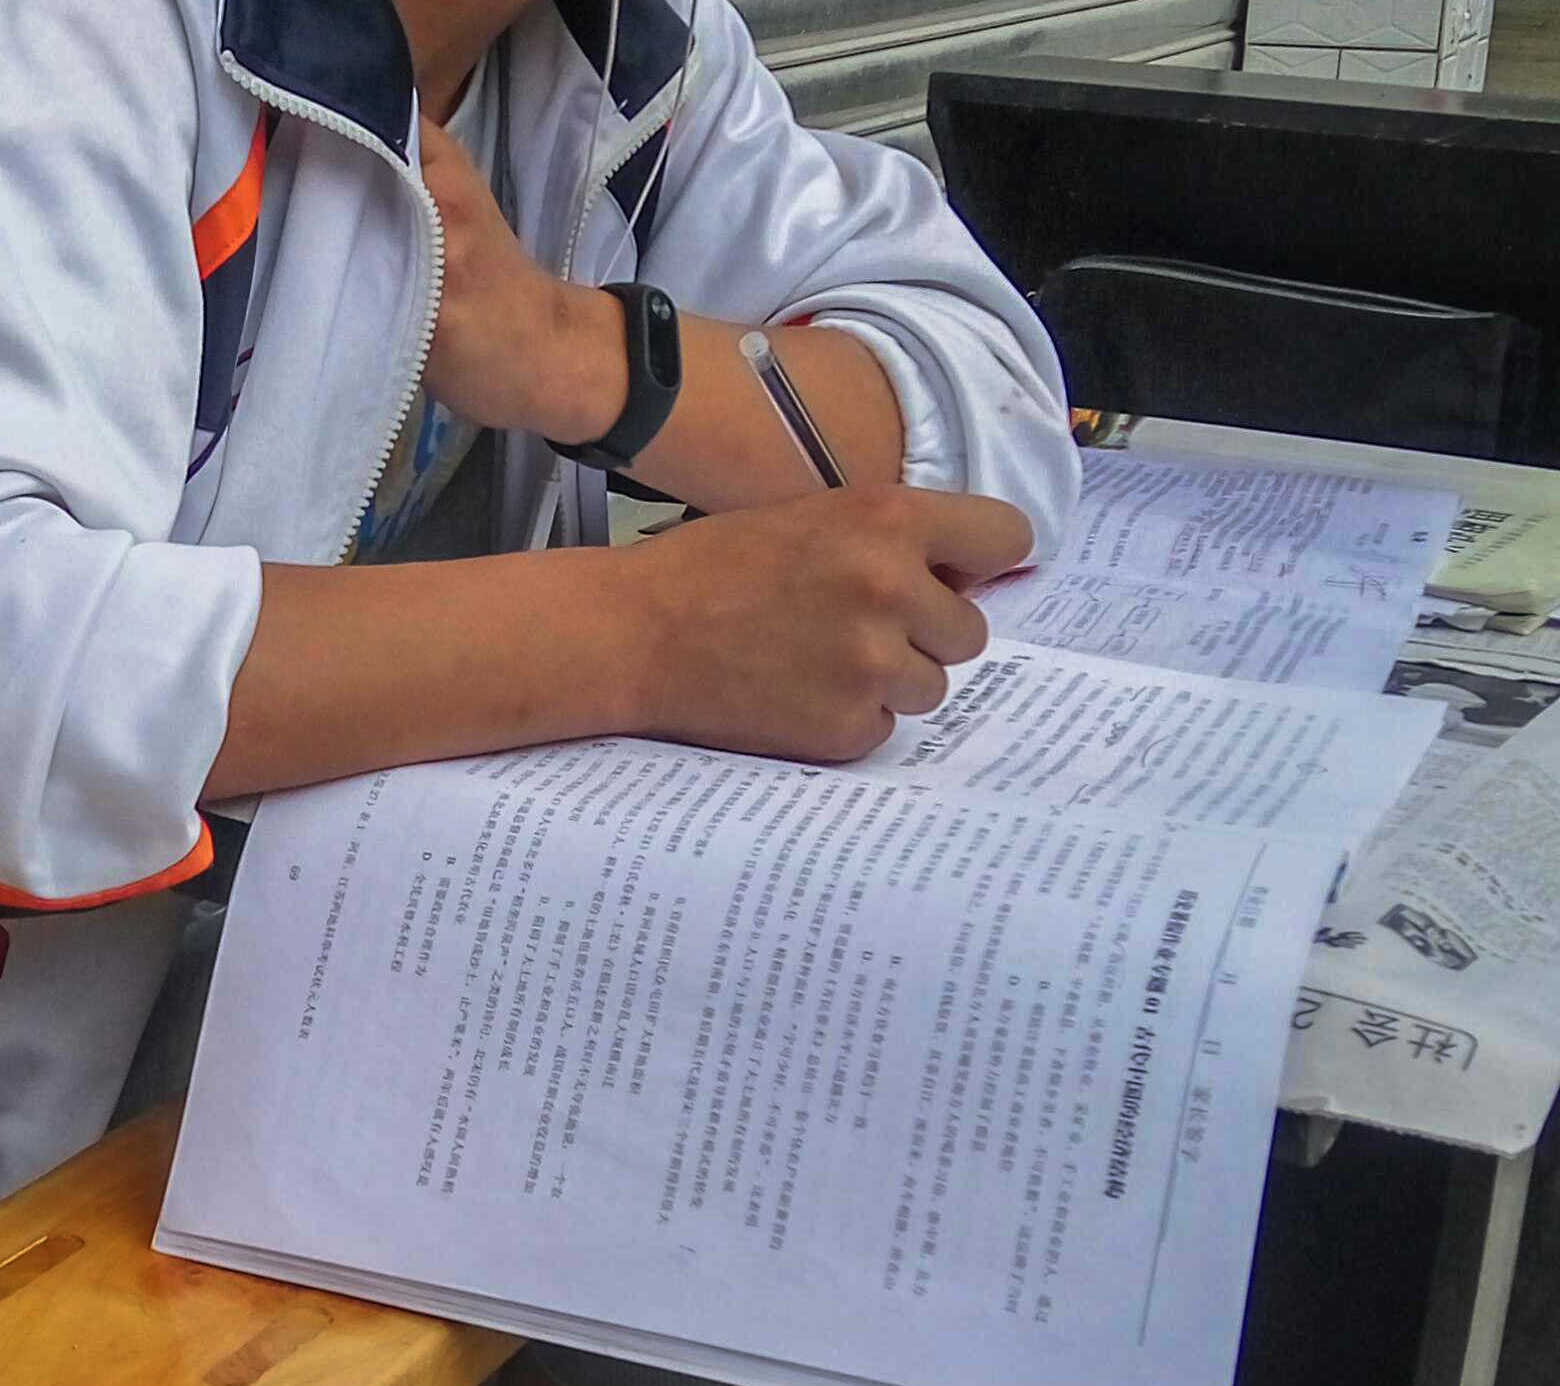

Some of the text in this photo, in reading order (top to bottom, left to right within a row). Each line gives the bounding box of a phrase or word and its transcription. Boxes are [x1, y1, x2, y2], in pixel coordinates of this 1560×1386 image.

[286, 864, 301, 881] 69
[1351, 1007, 1457, 1065] 社会
[1101, 1024, 1155, 1199] 古代中国的经济结构
[1178, 1084, 1212, 1164] 家长签字
